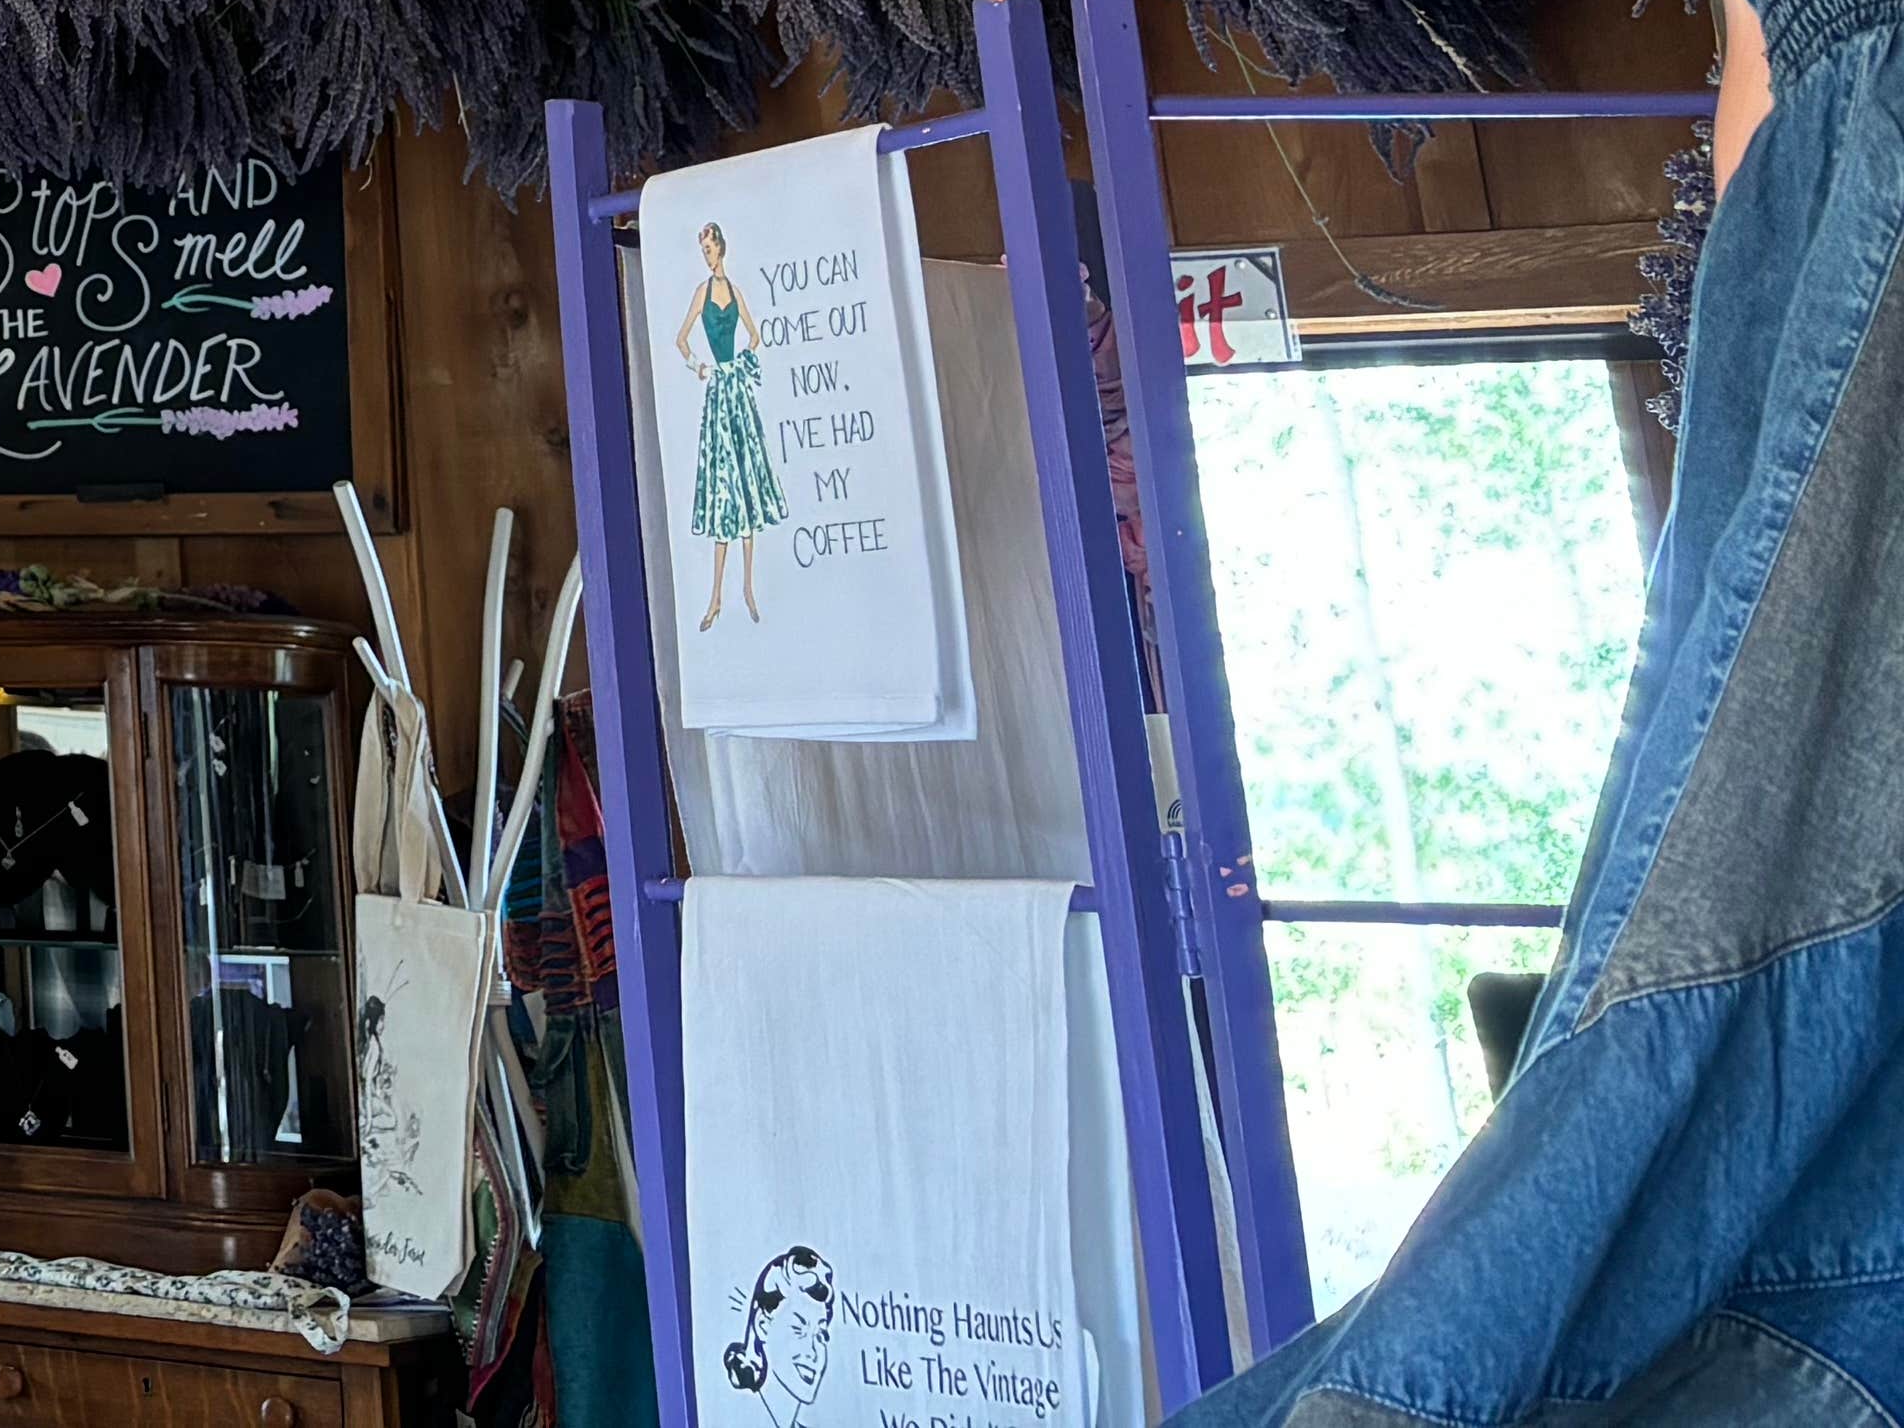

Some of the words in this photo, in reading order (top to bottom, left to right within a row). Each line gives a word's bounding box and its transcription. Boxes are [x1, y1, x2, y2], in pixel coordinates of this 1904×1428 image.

[168, 158, 278, 216] AND
[760, 258, 808, 307] YOU
[816, 249, 859, 286] CAN
[760, 310, 824, 348] COME
[828, 301, 868, 337] OUT
[1176, 265, 1243, 364] it
[790, 360, 851, 398] NOW.
[779, 416, 826, 464] I'VE
[830, 409, 875, 447] HAD
[813, 468, 851, 503] MY
[793, 518, 889, 569] COFFEE
[841, 1290, 946, 1346] Nothing
[953, 1301, 1034, 1347] Haunts
[1035, 1310, 1063, 1350] Us
[861, 1346, 913, 1390] Like
[920, 1353, 969, 1397] The
[974, 1359, 1061, 1420] Vintage
